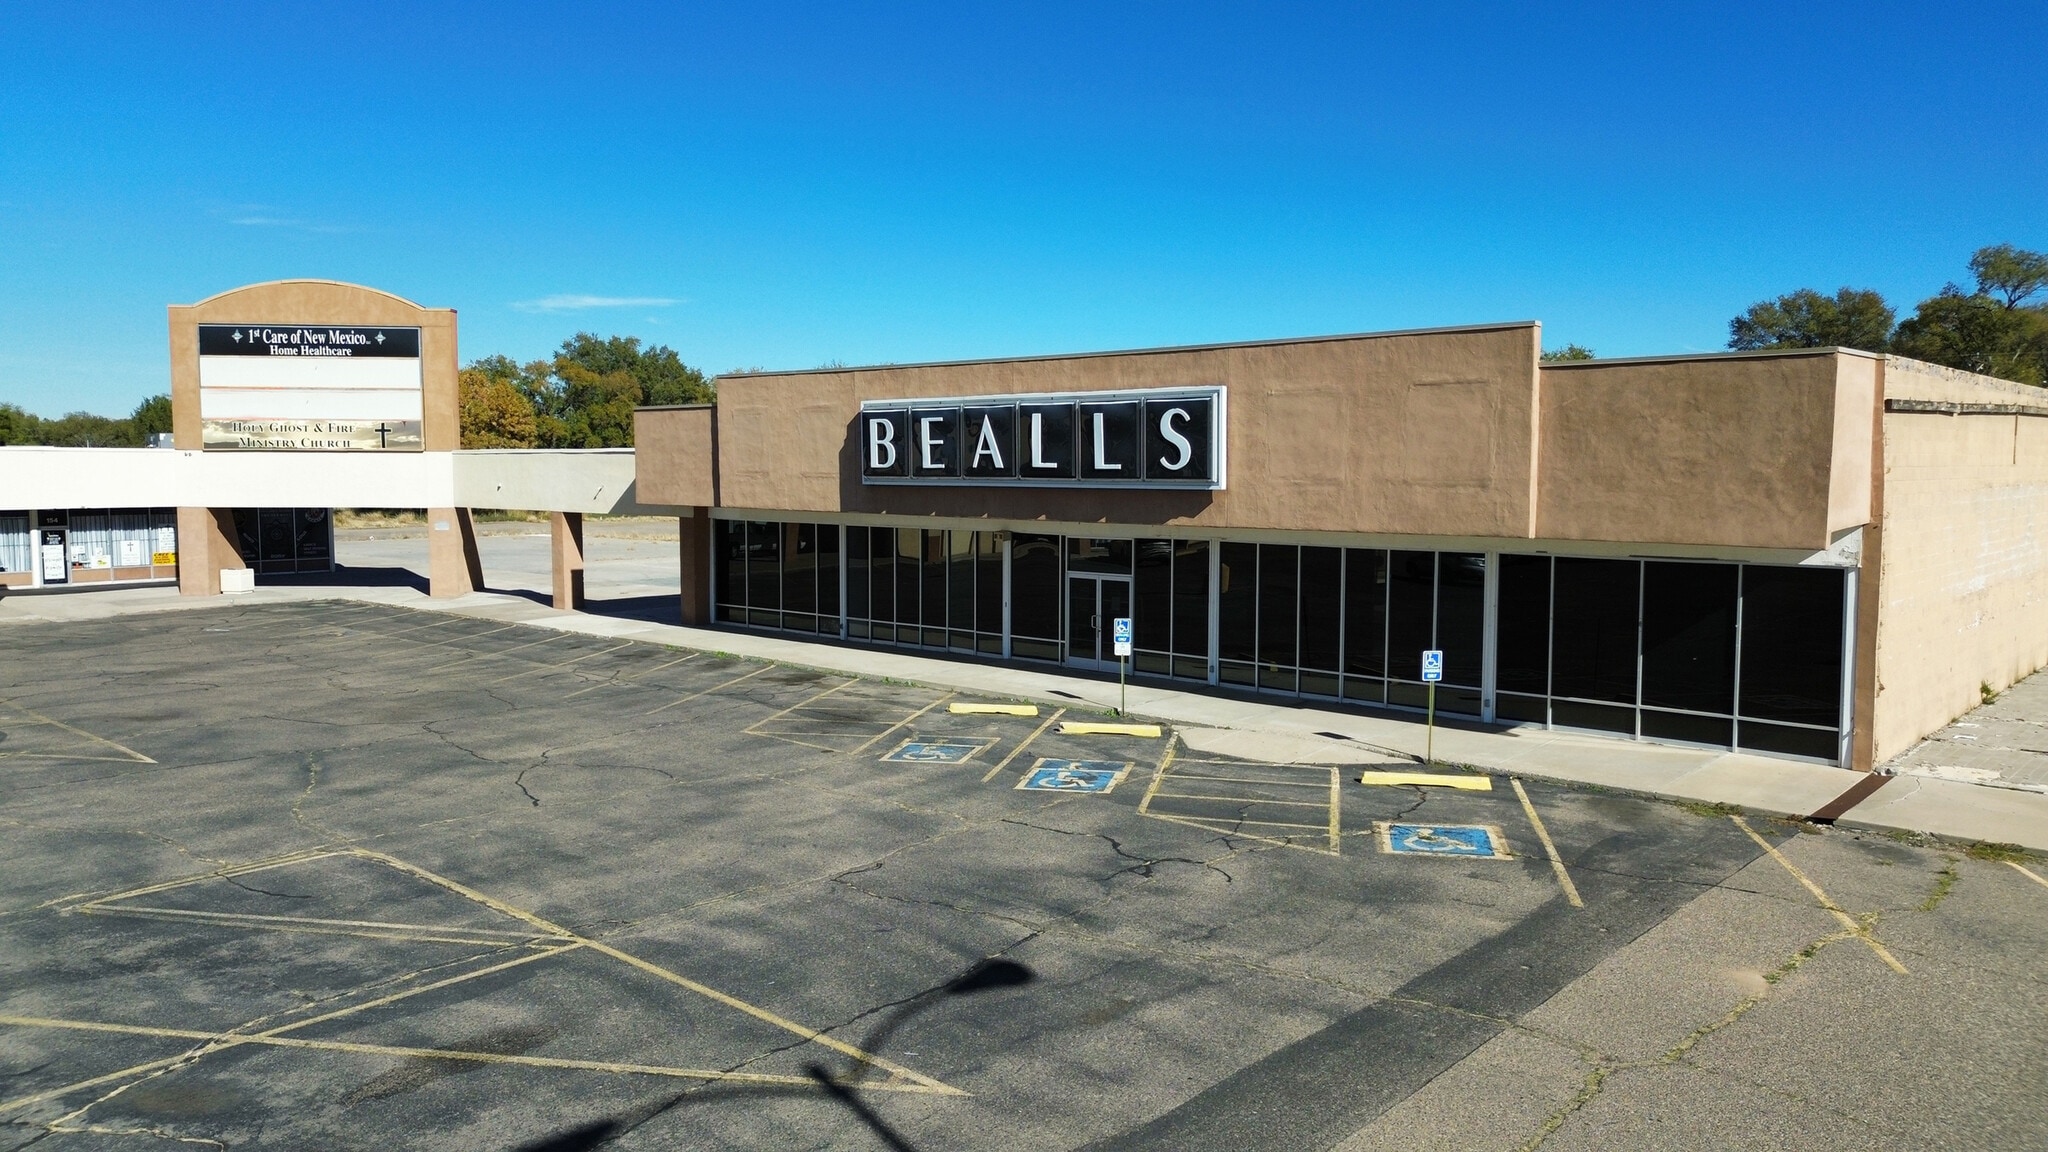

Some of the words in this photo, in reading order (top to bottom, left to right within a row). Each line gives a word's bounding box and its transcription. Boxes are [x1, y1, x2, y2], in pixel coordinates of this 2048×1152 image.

[248, 329, 260, 343] 1st
[262, 329, 289, 344] Care
[290, 329, 302, 344] of
[303, 329, 326, 344] New
[328, 330, 366, 345] Mexico
[269, 344, 299, 356] Home
[300, 345, 352, 356] Healthcare
[269, 423, 309, 433] GHOST
[313, 423, 323, 433] &
[328, 423, 356, 433] FIRE
[239, 437, 296, 447] MINISTRY
[301, 438, 351, 448] CHURCH
[869, 408, 1192, 470] BEALLS
